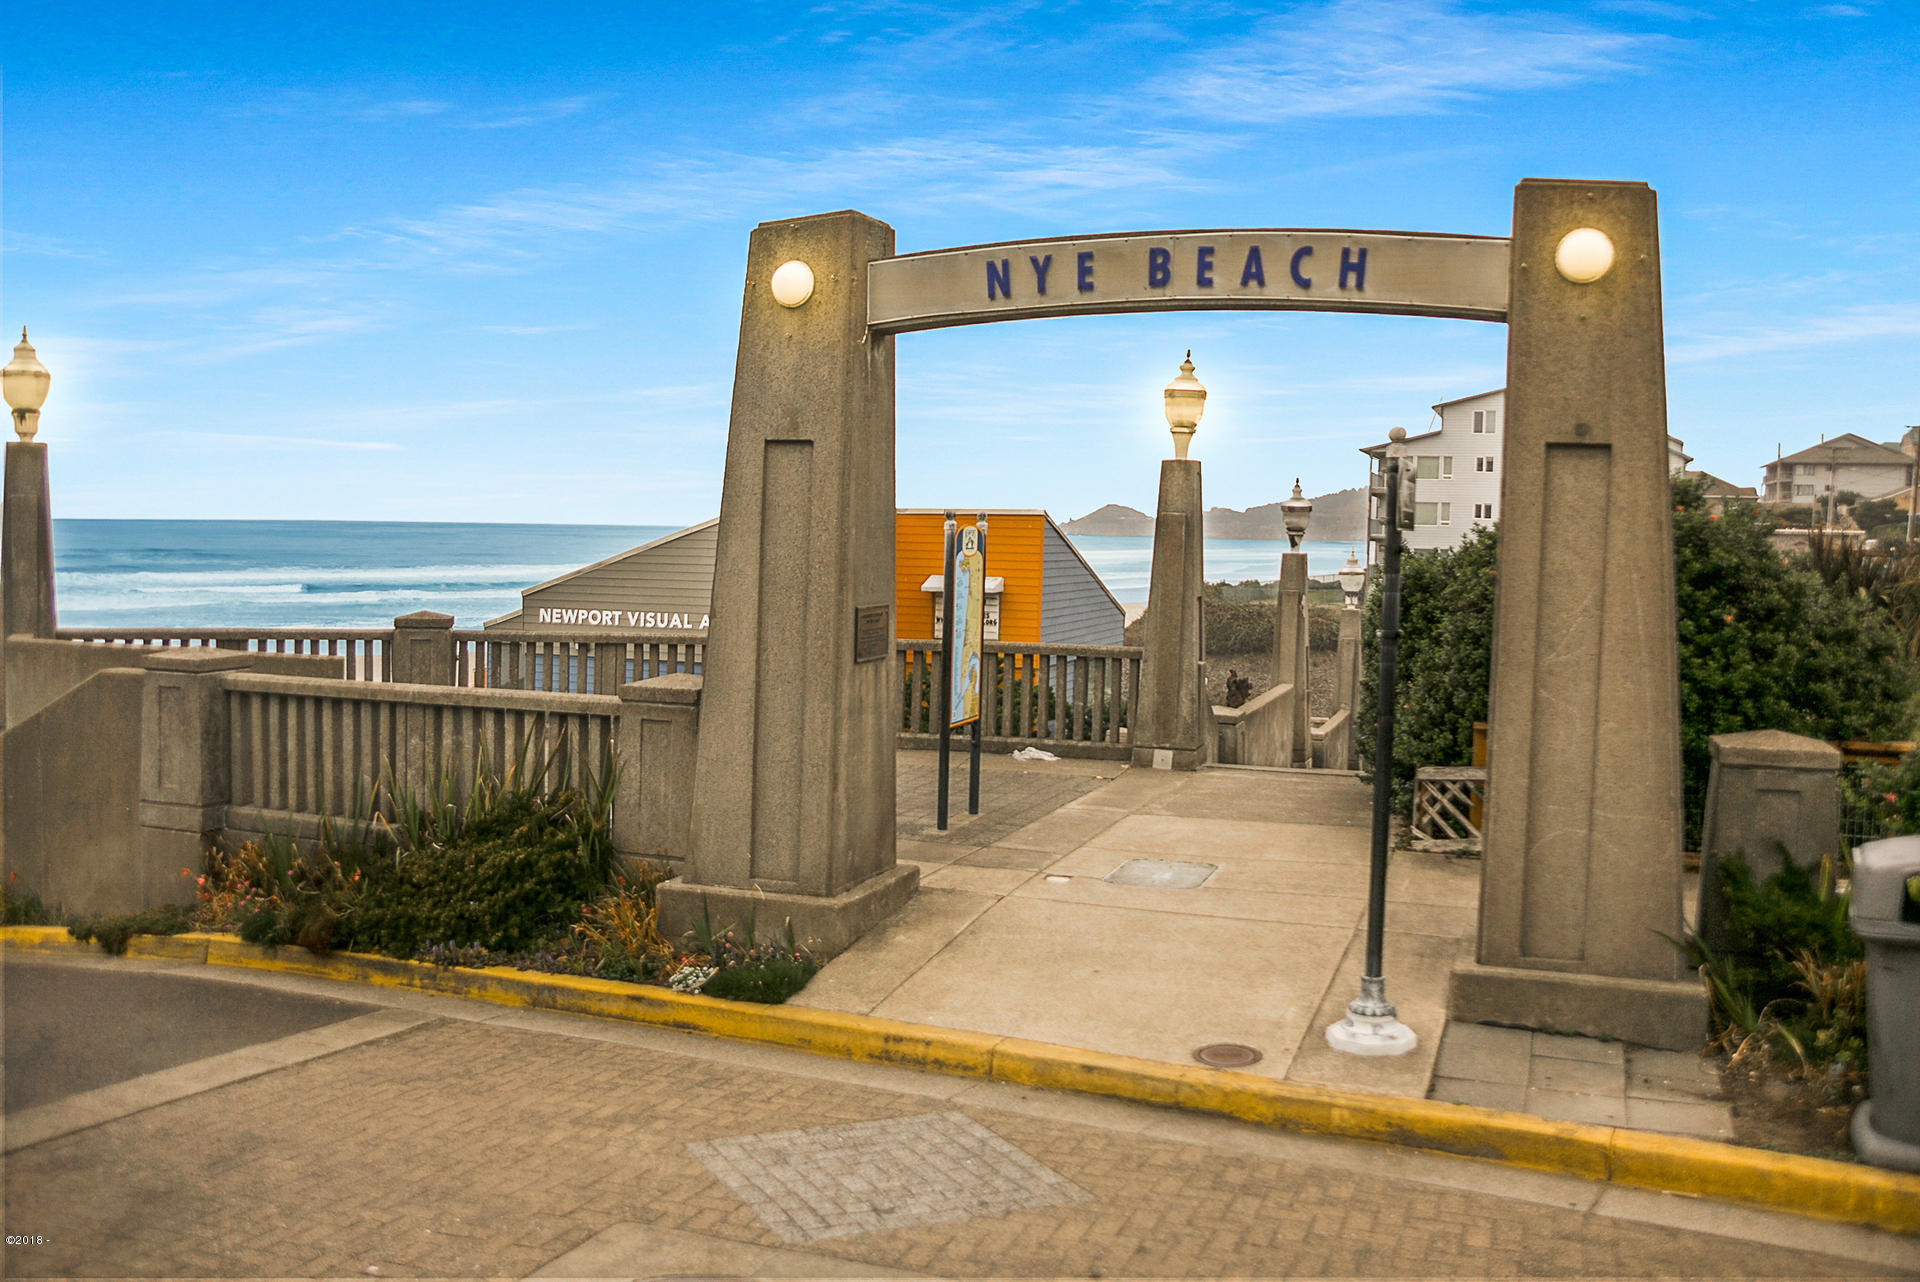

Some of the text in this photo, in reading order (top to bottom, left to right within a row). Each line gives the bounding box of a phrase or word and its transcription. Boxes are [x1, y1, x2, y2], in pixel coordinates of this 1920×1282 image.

[986, 245, 1367, 299] NYE BEACH
[539, 608, 623, 627] NEWPORT
[628, 611, 693, 629] VISUAL
